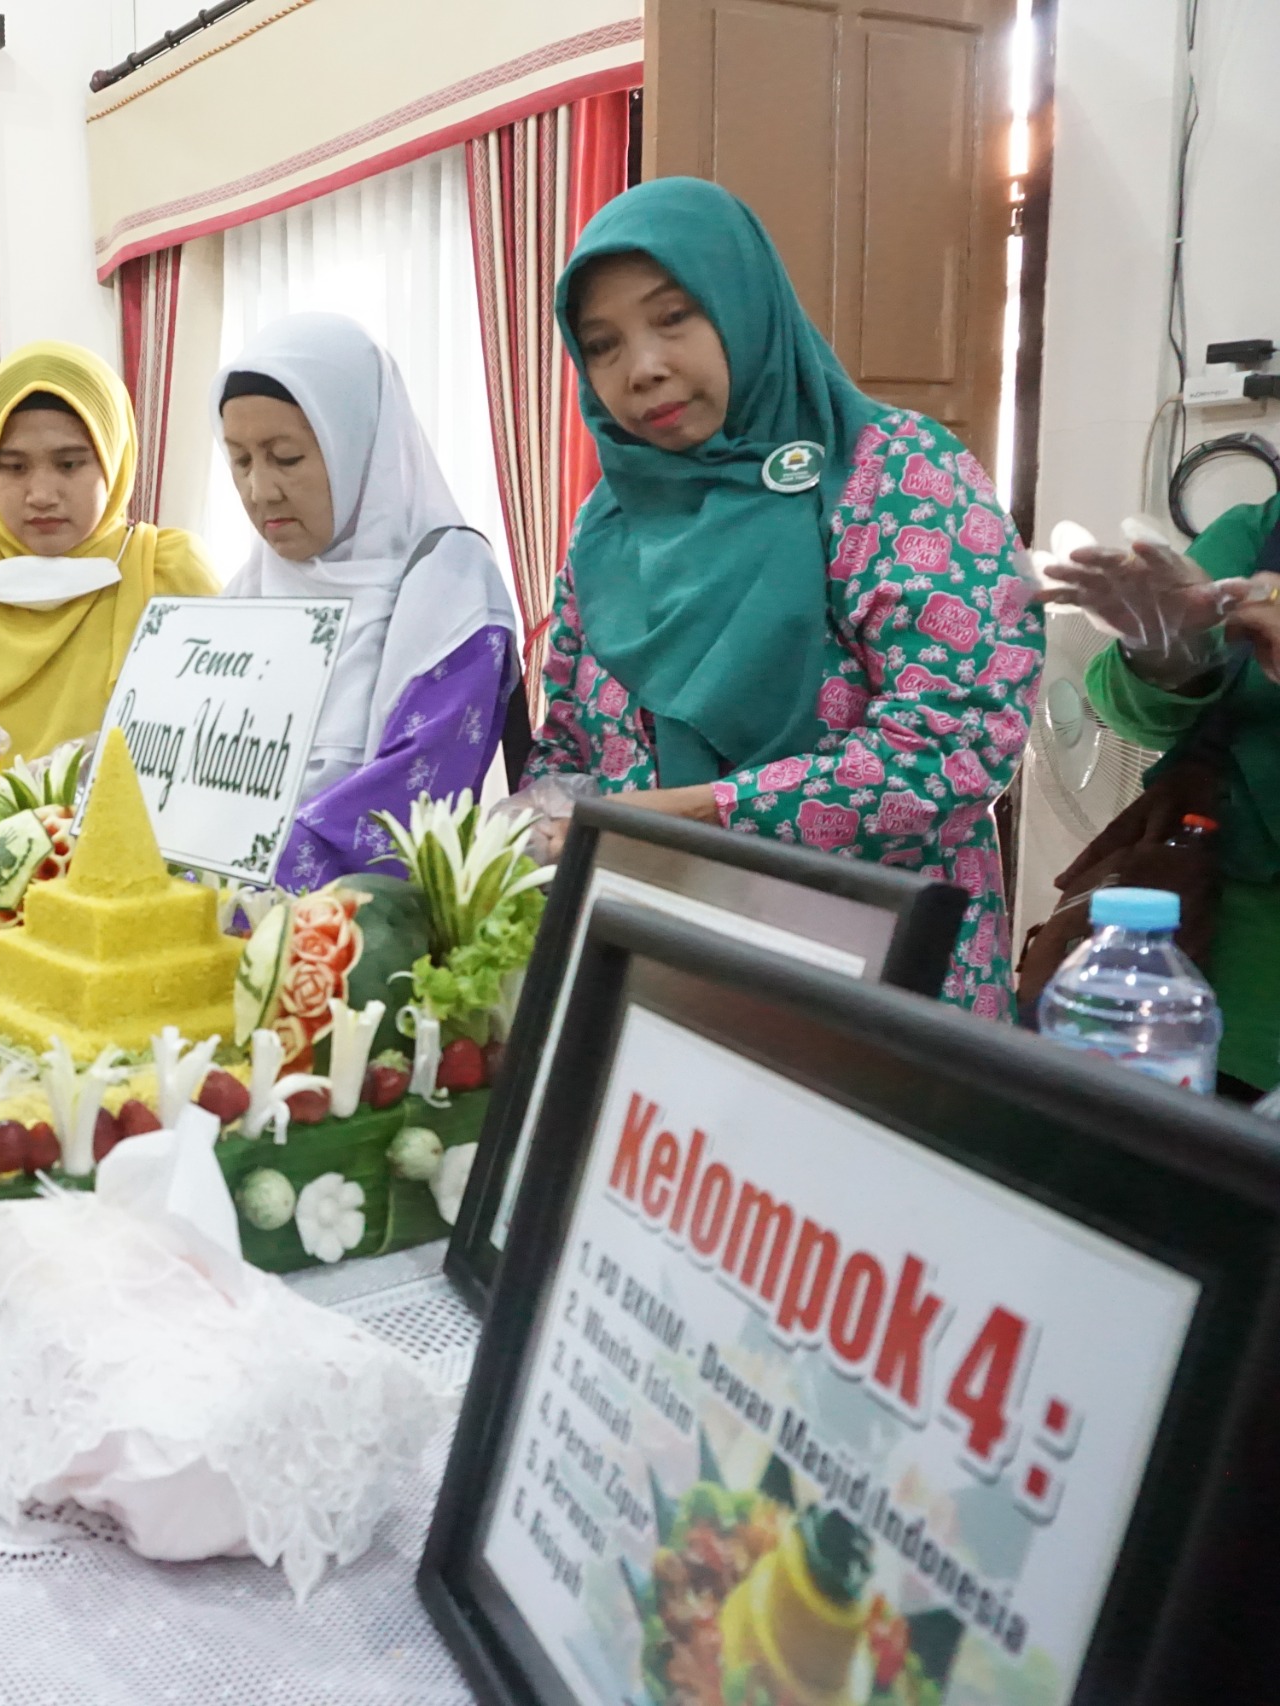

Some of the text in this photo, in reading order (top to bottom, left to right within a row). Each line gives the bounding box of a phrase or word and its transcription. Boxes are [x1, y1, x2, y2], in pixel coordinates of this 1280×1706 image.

[175, 638, 254, 679] Tema
[563, 1289, 696, 1436] 2. Wanita Islam
[609, 1091, 945, 1409] Kelompok
[579, 1240, 592, 1279] 1.
[621, 1276, 686, 1354] BKMM
[698, 1340, 774, 1434] Dewan
[776, 1406, 870, 1512] Masjid
[870, 1486, 1029, 1655] Indonesia
